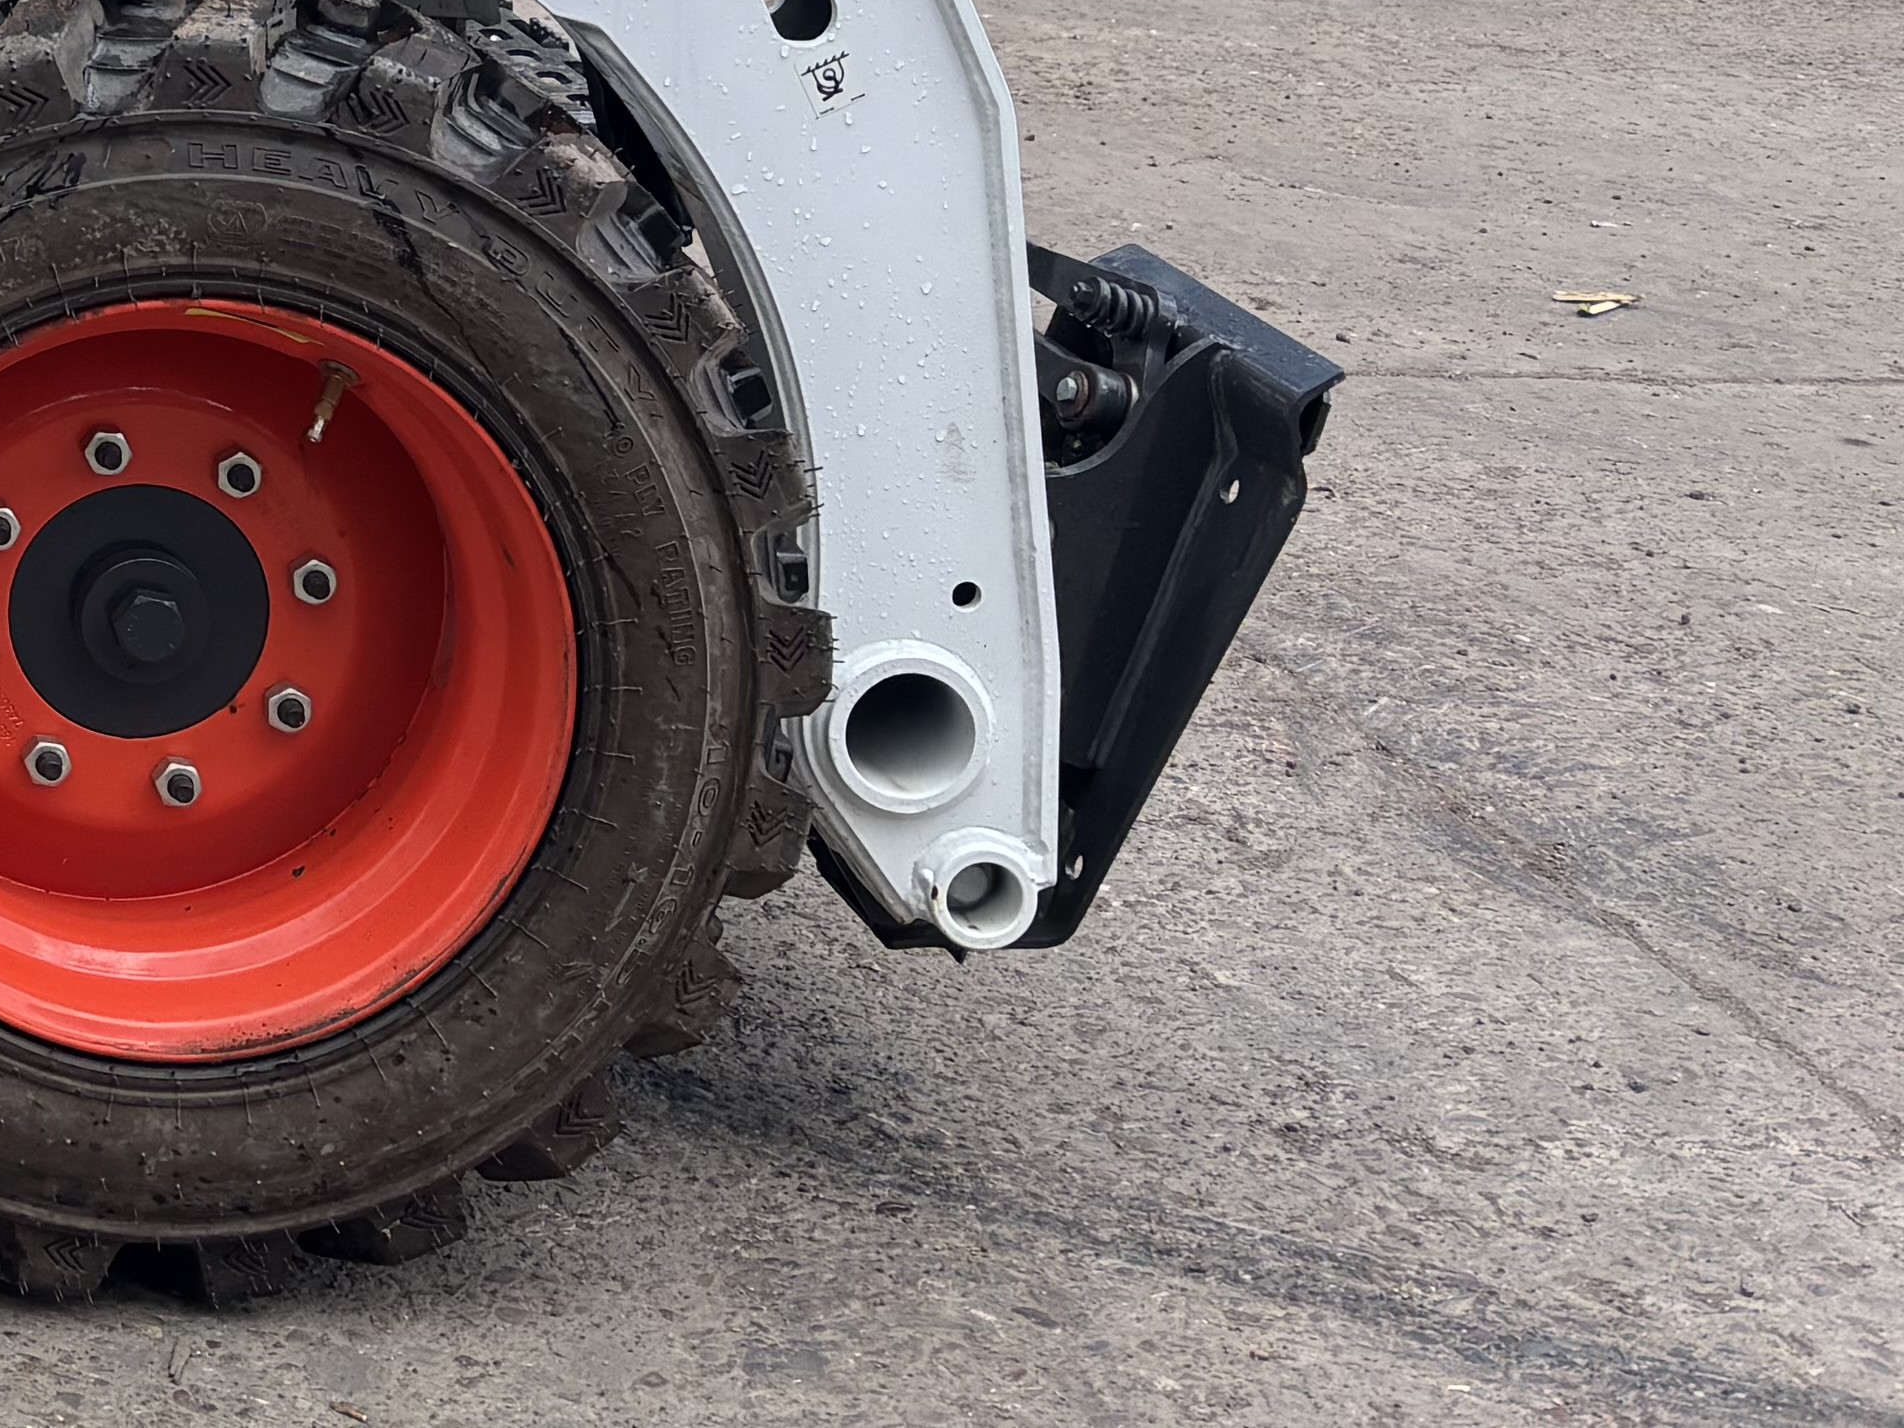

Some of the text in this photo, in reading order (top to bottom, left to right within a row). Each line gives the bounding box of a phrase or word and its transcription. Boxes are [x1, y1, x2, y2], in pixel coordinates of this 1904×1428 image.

[188, 140, 657, 413] HEAVY DUTY
[622, 460, 668, 521] PLY
[652, 539, 697, 667] RATING
